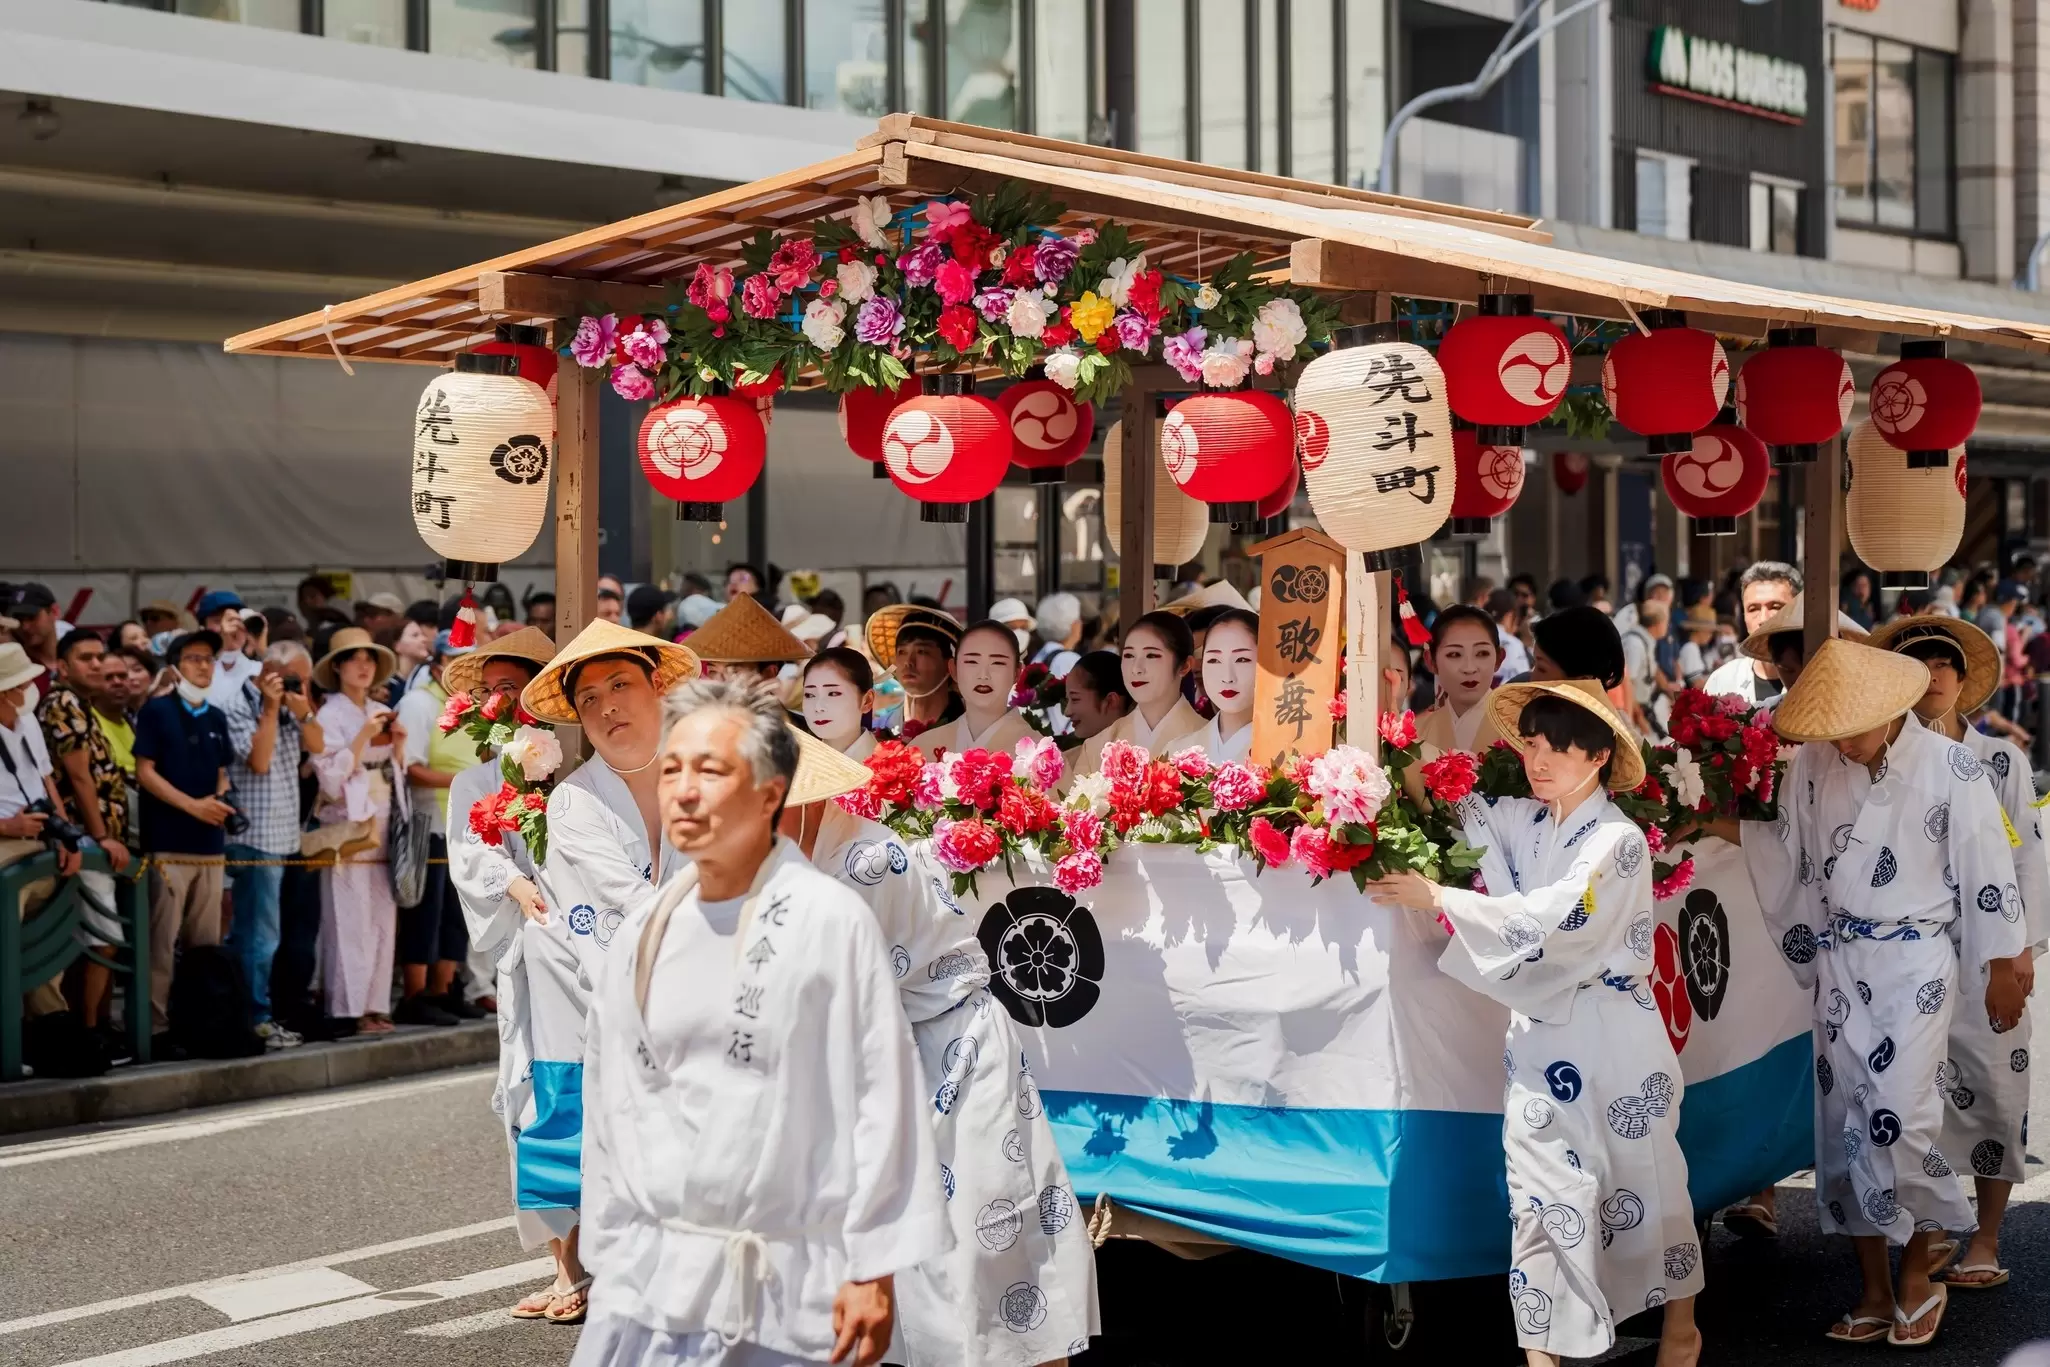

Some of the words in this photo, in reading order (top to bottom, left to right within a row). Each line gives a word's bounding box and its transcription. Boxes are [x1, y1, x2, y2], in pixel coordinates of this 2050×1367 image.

[1689, 36, 1735, 99] MOS
[1736, 47, 1807, 116] BURGER
[415, 388, 460, 529] 先斗町
[1362, 353, 1441, 504] 先斗町
[1273, 616, 1323, 767] 歌舞
[727, 894, 791, 1063] 花傘巡行
